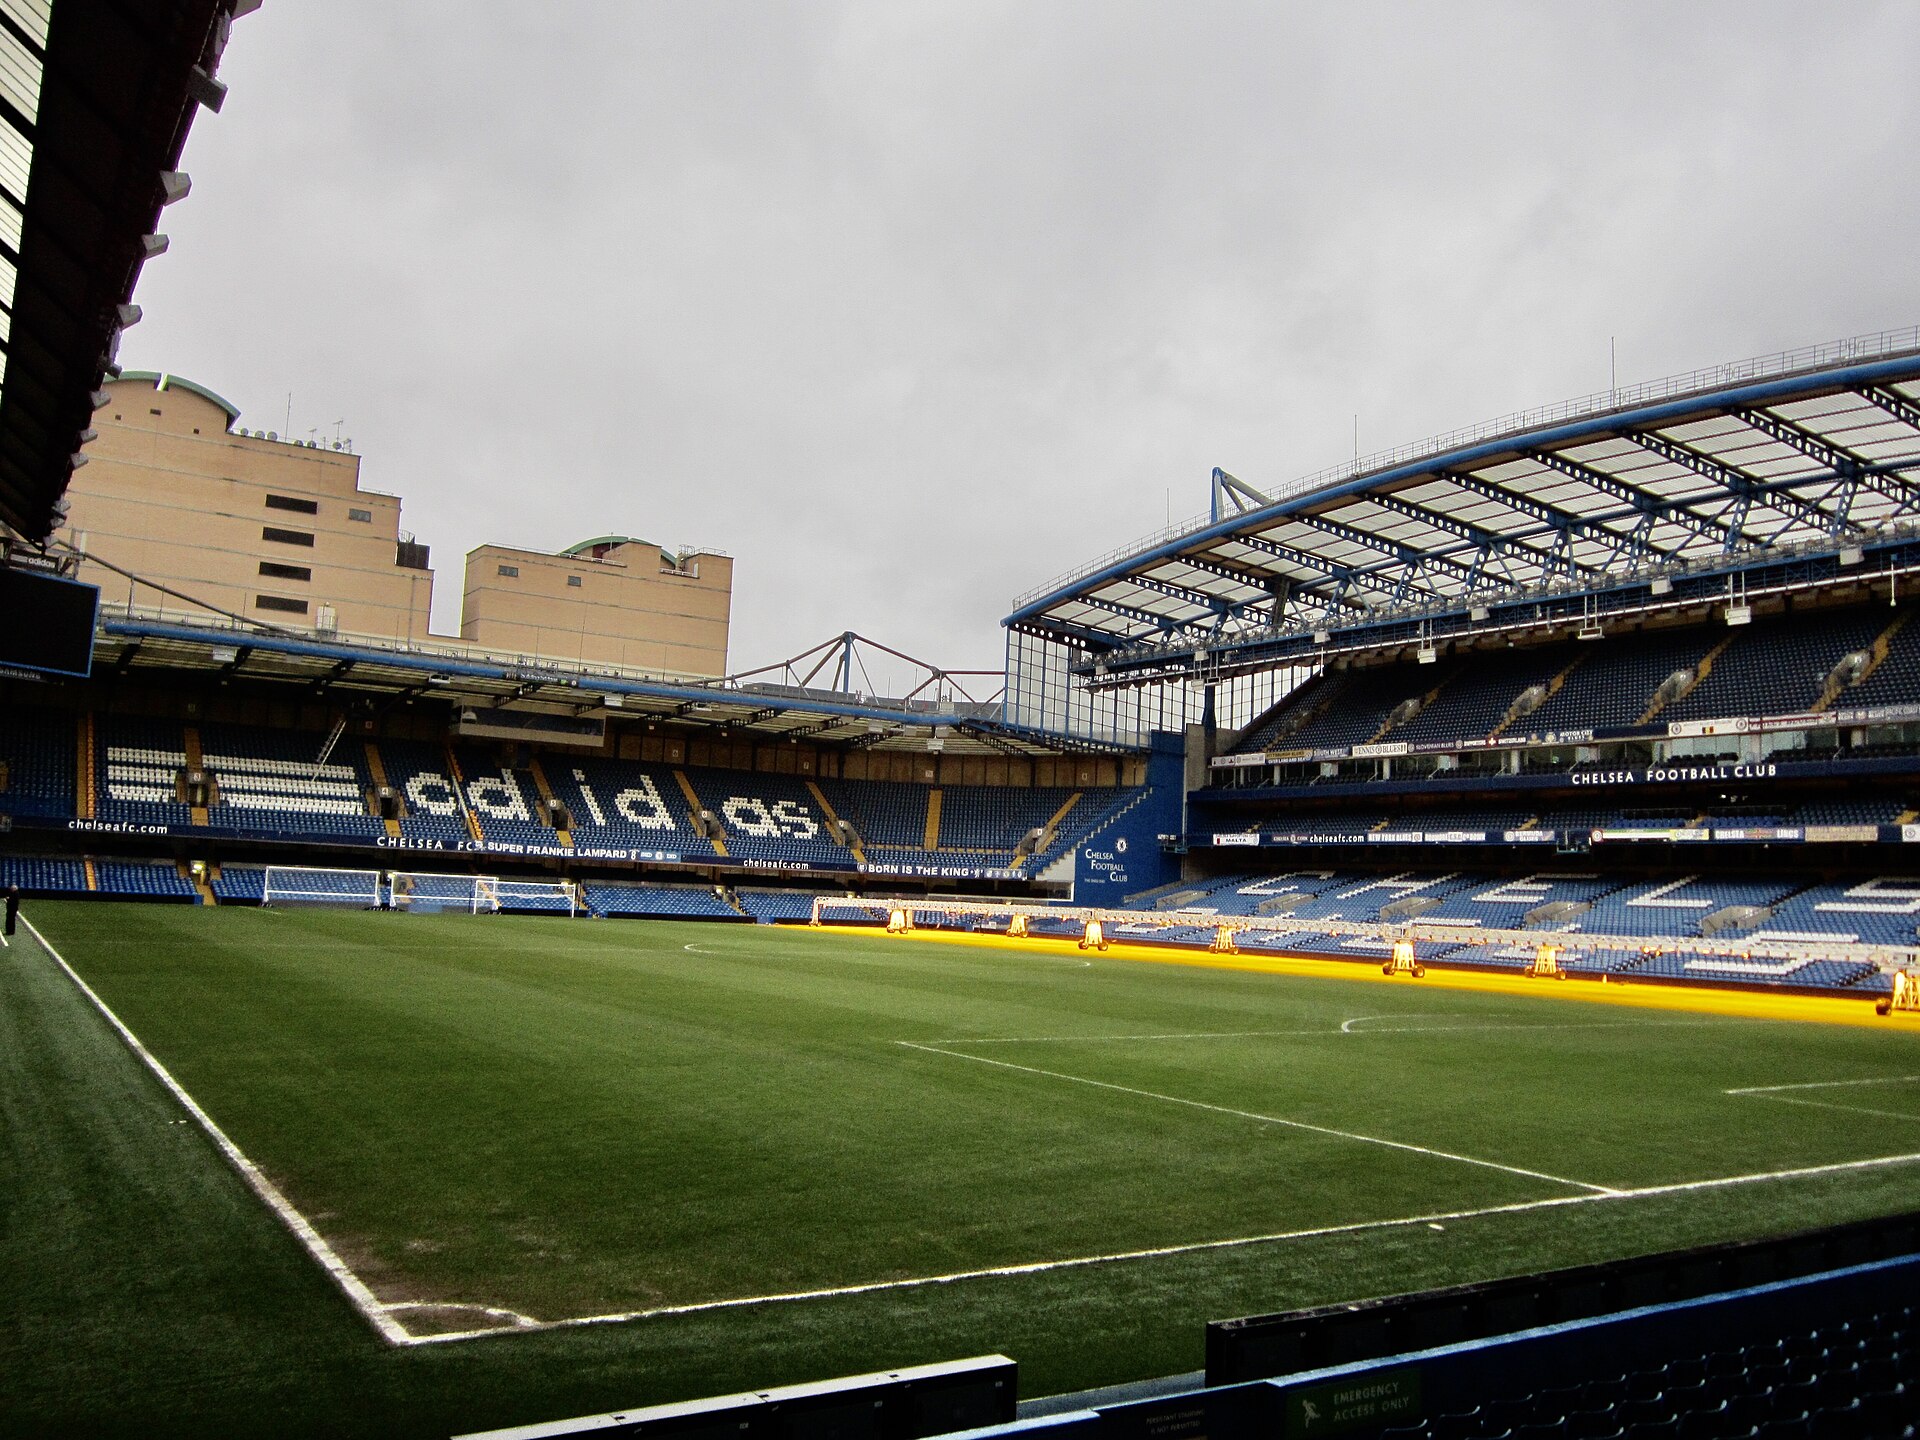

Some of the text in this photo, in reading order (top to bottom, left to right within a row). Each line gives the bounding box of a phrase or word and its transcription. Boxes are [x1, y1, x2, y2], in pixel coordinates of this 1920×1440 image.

[28, 557, 55, 569] adidas
[1572, 765, 1776, 785] CHELSEA FOOTBALL CLUB
[68, 819, 168, 834] chelseafc.com
[1310, 833, 1364, 843] chelseafc.com
[1715, 830, 1744, 839] CHELSEA
[377, 837, 473, 851] CHELSEA FC
[488, 842, 523, 854] SUPER
[526, 845, 574, 857] FRANKIE
[577, 848, 627, 859] LAMPARD
[1085, 848, 1114, 860] CHELSEA
[743, 858, 809, 870] chelseafc.com
[1091, 860, 1125, 872] FOOTBALL
[868, 864, 969, 877] BORN IS THE KING
[1110, 871, 1128, 882] CLUB
[1333, 1381, 1399, 1405] EMERGENCY
[1333, 1396, 1409, 1422] ACCESS ONLY
